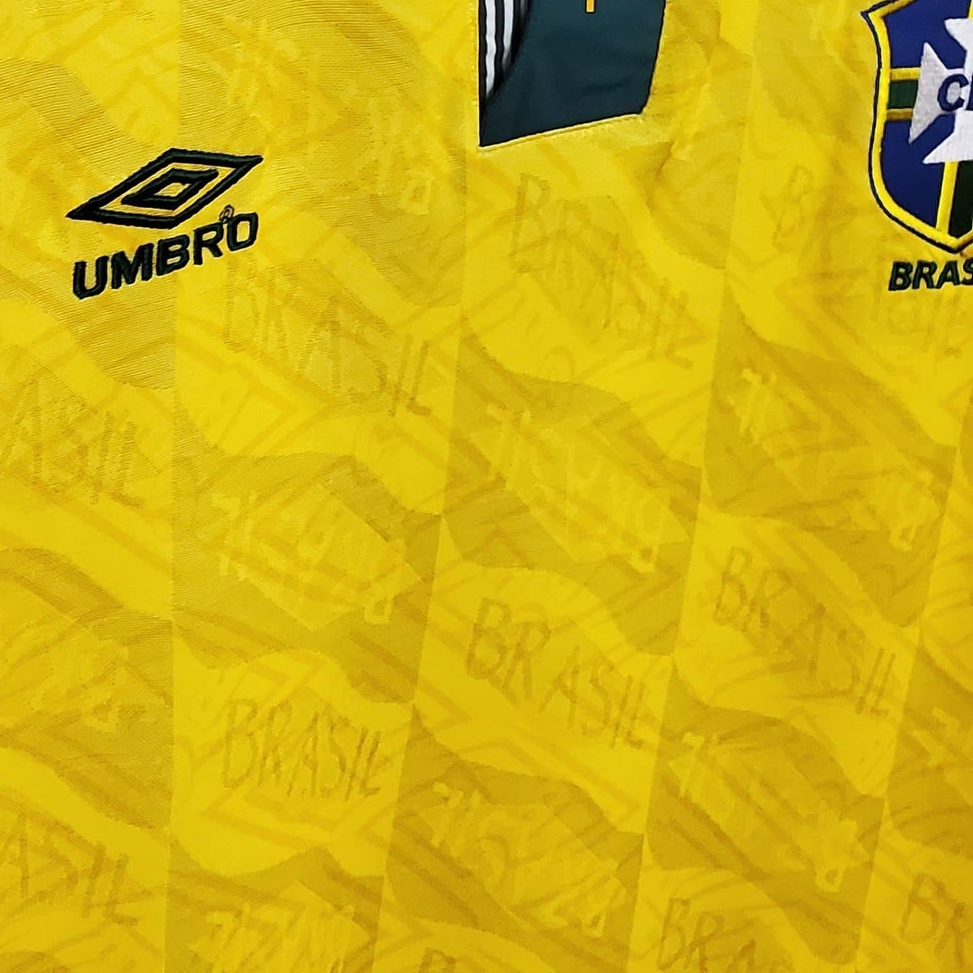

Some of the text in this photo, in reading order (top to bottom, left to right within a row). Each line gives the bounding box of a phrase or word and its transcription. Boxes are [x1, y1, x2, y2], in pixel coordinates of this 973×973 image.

[937, 73, 973, 112] C
[72, 211, 259, 300] UMBRO
[465, 596, 645, 750] BRASIL
[220, 697, 391, 802] BRASIL
